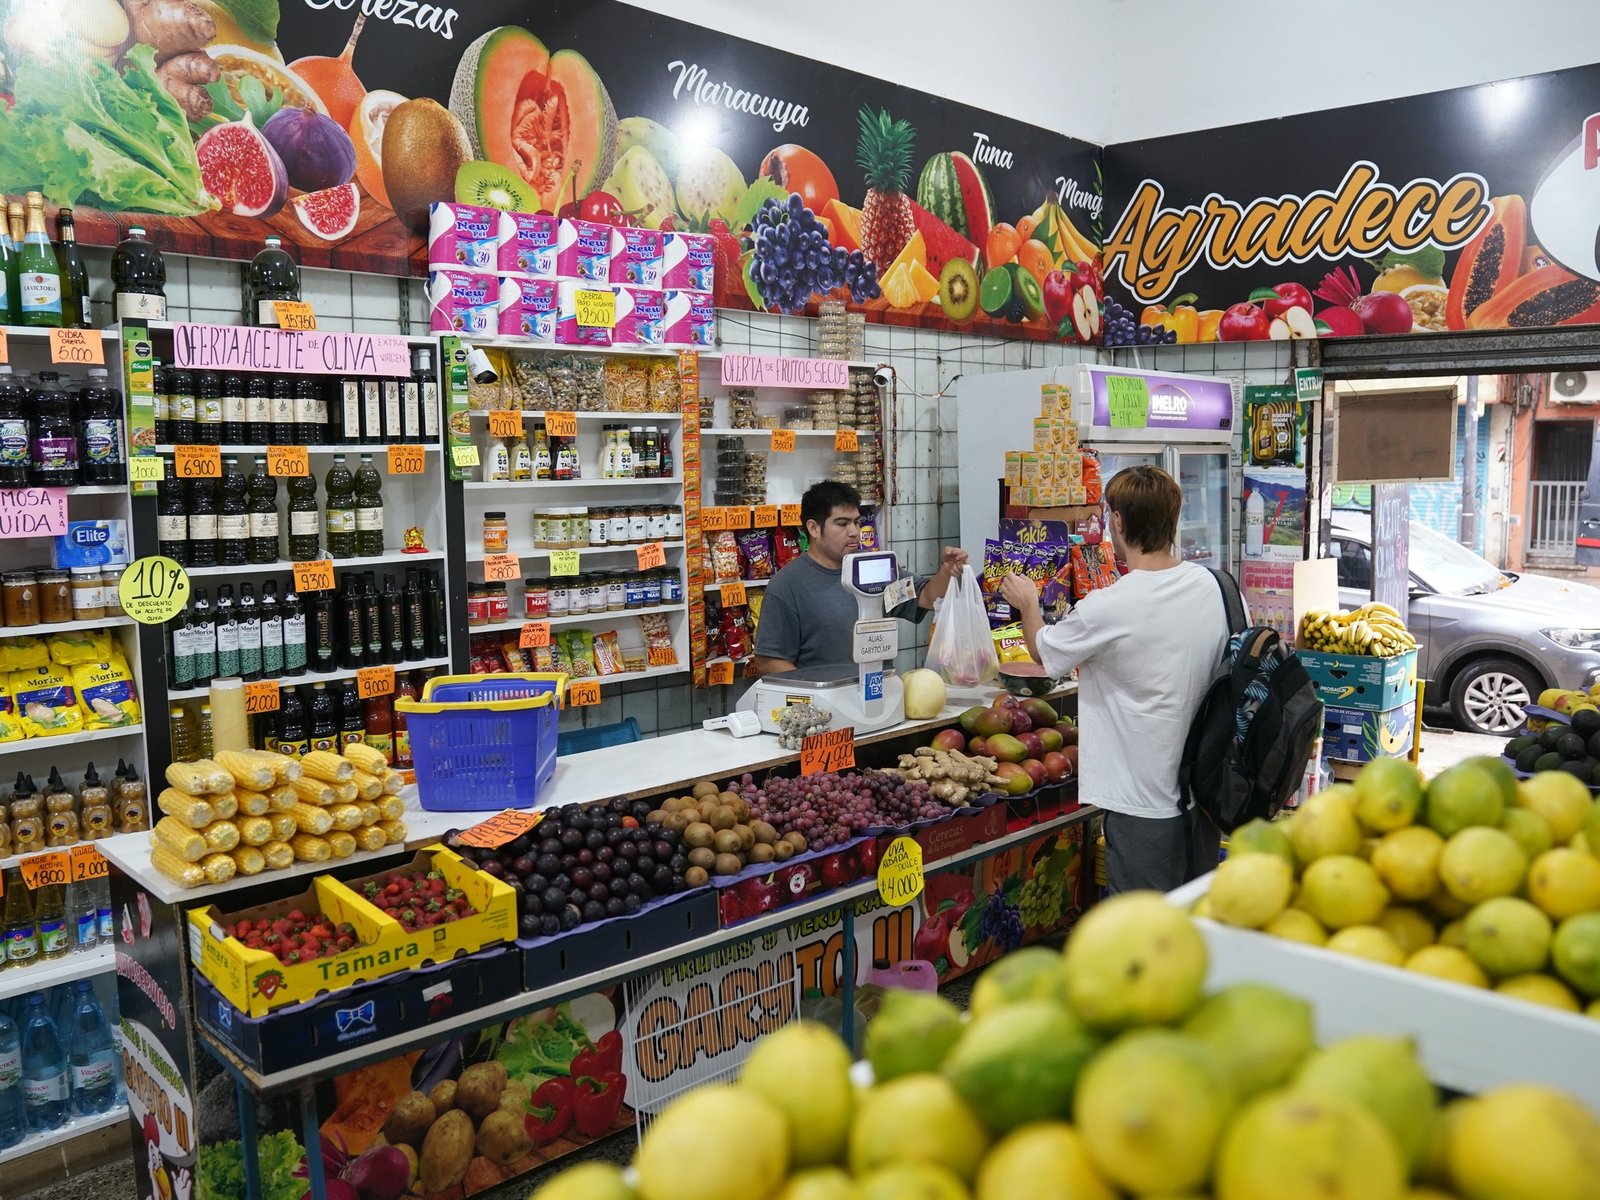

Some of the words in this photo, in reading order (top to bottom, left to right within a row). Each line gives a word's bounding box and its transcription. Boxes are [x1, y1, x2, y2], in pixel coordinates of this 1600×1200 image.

[304, 0, 459, 40] rezas
[667, 60, 810, 132] Maracuya
[973, 131, 1014, 169] Tuna
[1102, 160, 1494, 304] Agradece
[176, 325, 240, 367] OFERTA
[242, 328, 304, 369] ACEITE
[308, 339, 319, 349] DE
[378, 338, 406, 347] EXTRA
[723, 355, 763, 383] OFERTA
[765, 363, 774, 372] DE
[776, 358, 811, 384] FRUTOS
[814, 362, 847, 385] SECOS
[76, 529, 107, 543] Elite
[1016, 525, 1047, 544] Takis
[132, 561, 184, 599] 10%
[27, 676, 64, 687] Morixe
[90, 671, 124, 683] Morixe
[871, 685, 883, 695] EX
[802, 733, 822, 751] UVA
[928, 823, 964, 845] Cerezas
[889, 842, 905, 858] UVA
[317, 941, 420, 981] Tamara
[116, 950, 176, 1031] UTOSERVICIO
